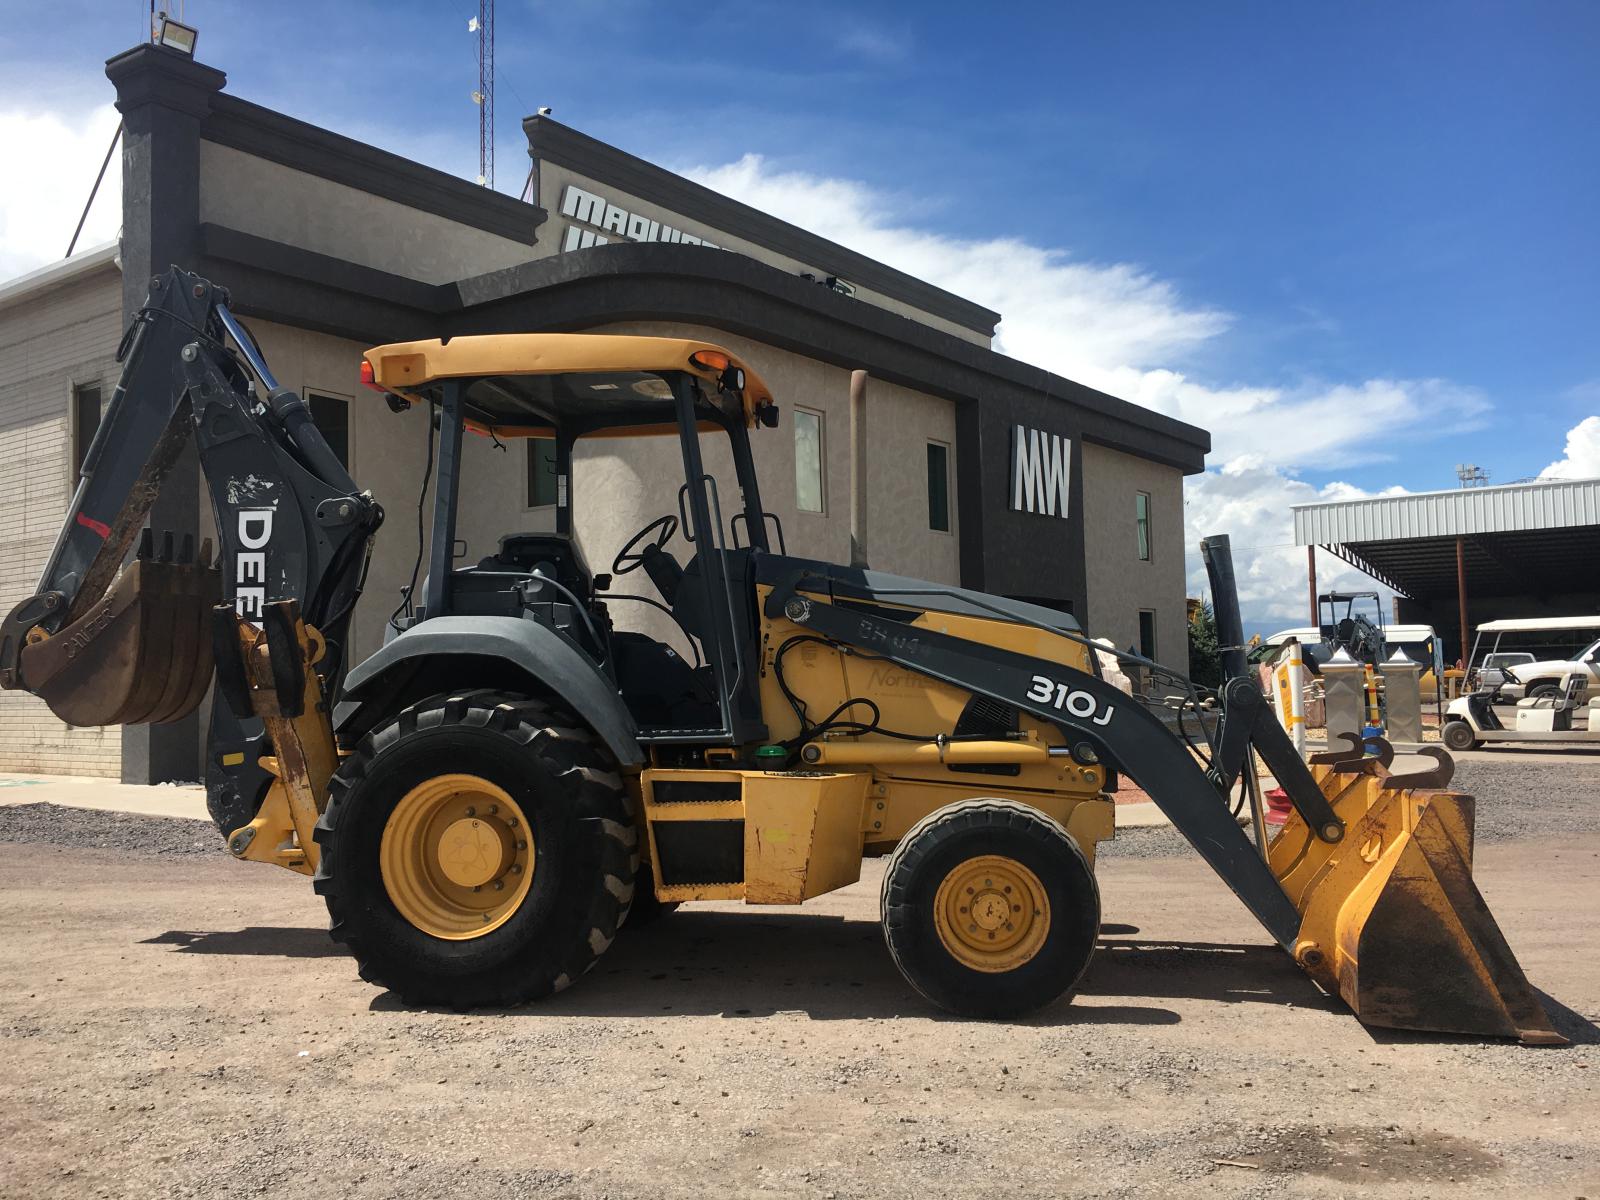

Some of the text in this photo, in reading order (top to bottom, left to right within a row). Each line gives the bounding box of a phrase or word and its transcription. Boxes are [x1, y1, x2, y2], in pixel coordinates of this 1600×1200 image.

[1013, 424, 1072, 519] MW
[236, 510, 273, 631] DEE
[1026, 675, 1114, 726] 310J
